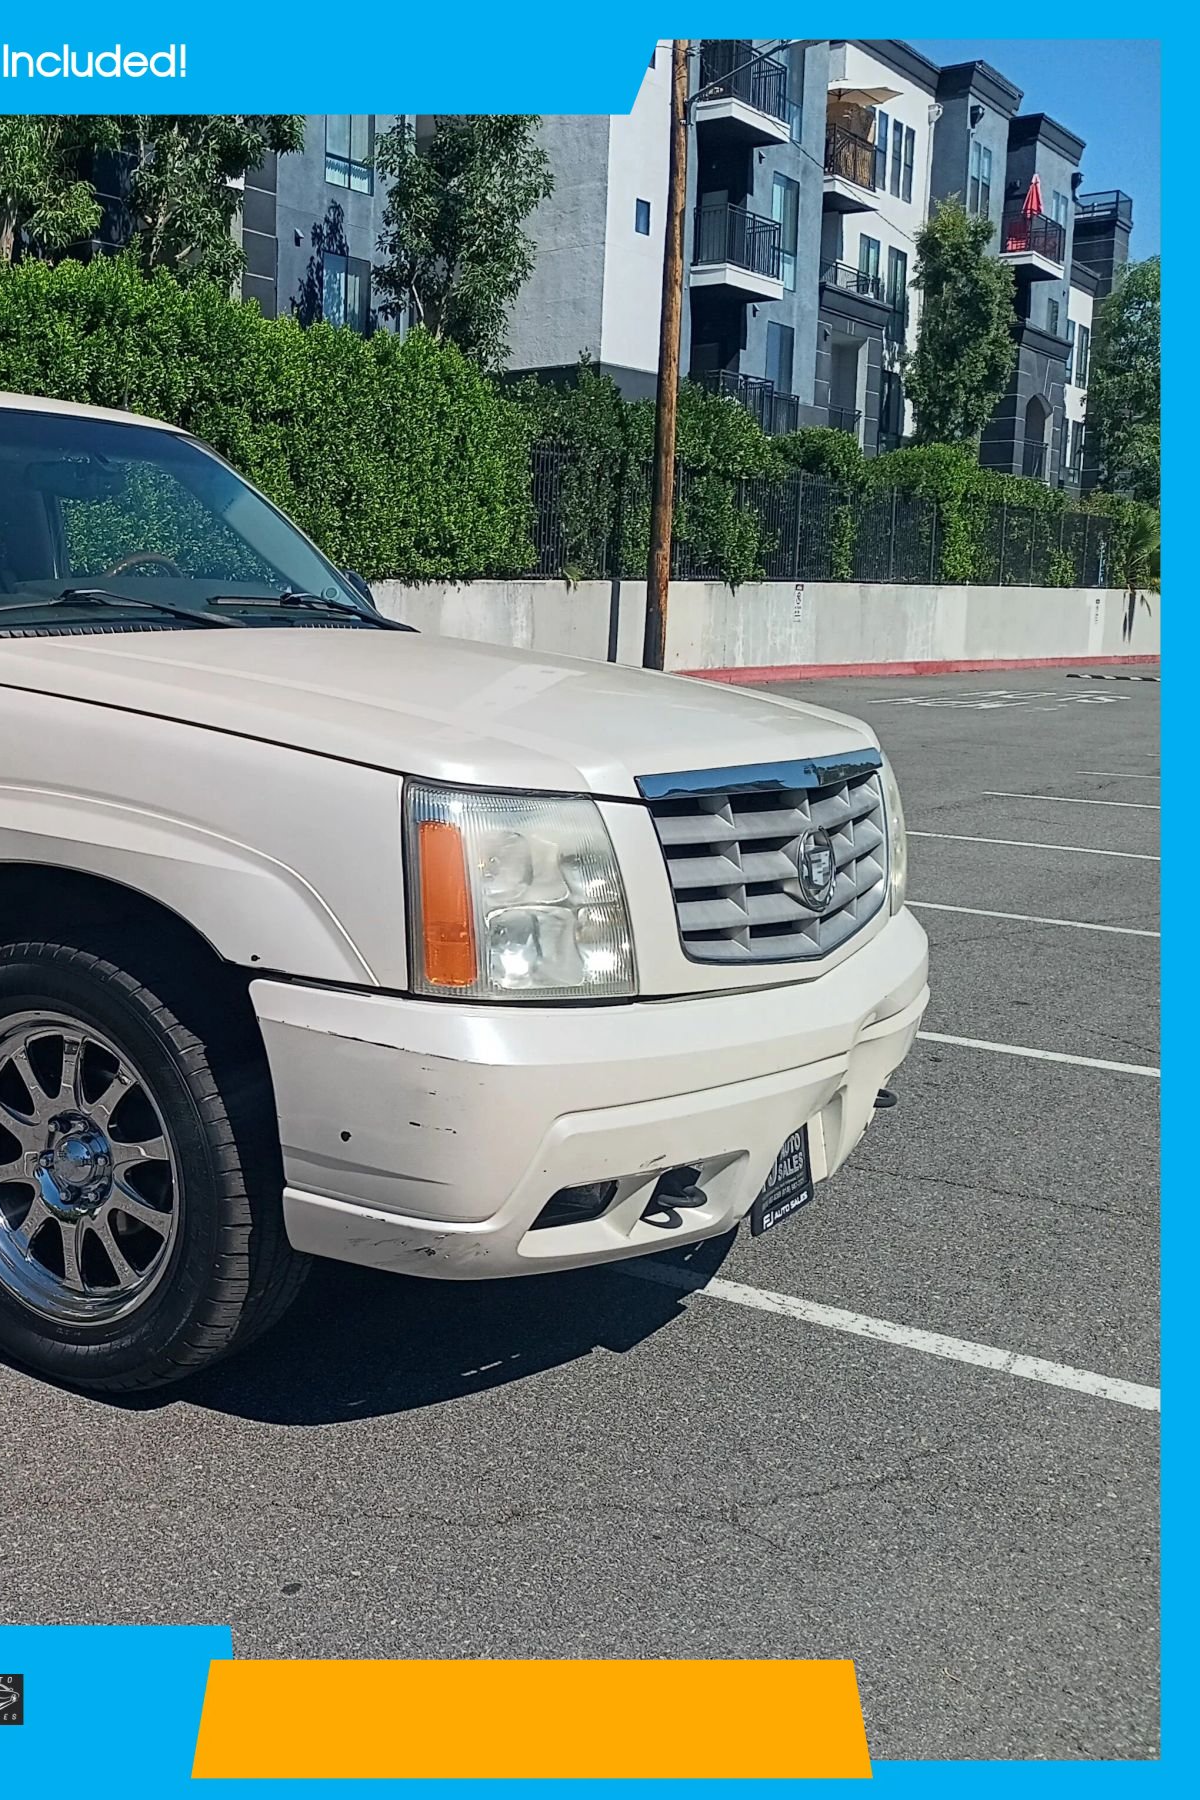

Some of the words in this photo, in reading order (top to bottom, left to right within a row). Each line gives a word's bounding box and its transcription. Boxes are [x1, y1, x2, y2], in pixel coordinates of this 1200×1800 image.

[780, 1132, 801, 1160] AUTO
[777, 1151, 804, 1181] SALES
[763, 1211, 774, 1230] FJ
[774, 1203, 790, 1220] AUTO
[790, 1190, 808, 1210] SALES
